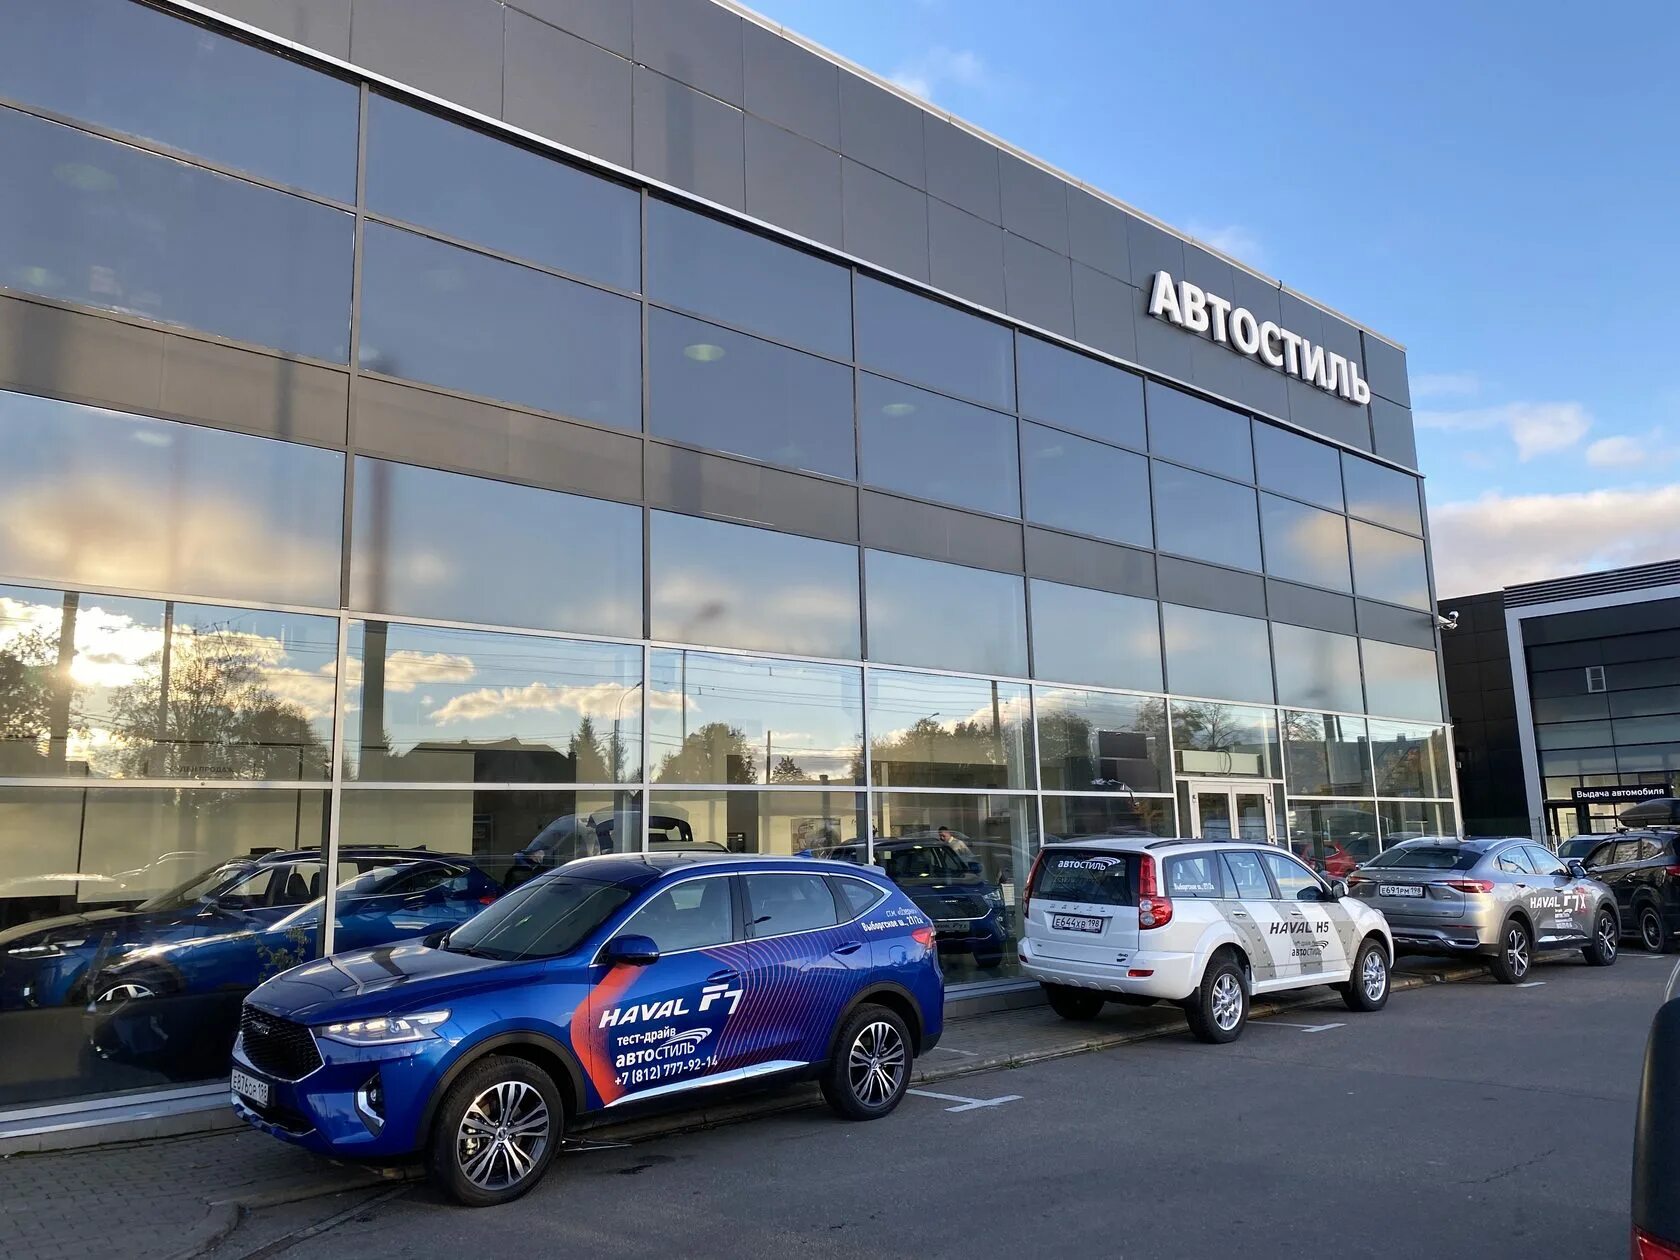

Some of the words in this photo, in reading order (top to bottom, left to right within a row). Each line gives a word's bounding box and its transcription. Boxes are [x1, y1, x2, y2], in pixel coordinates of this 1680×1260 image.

[1149, 270, 1371, 405] АВТОСТИЛЬ
[1576, 790, 1610, 799] Выдача
[1611, 787, 1665, 797] автомобиля
[1530, 895, 1561, 909] HAVAL
[861, 919, 899, 932] Выборгское
[1087, 919, 1100, 929] 198
[1269, 921, 1313, 935] HAVAL
[1316, 921, 1329, 933] H5
[598, 998, 690, 1029] HAVAL
[698, 983, 744, 1015] F7
[617, 1026, 676, 1047] тест-драйв
[615, 1072, 629, 1086] +7
[631, 1065, 661, 1085] (812)
[663, 1054, 718, 1077] 777-92-14
